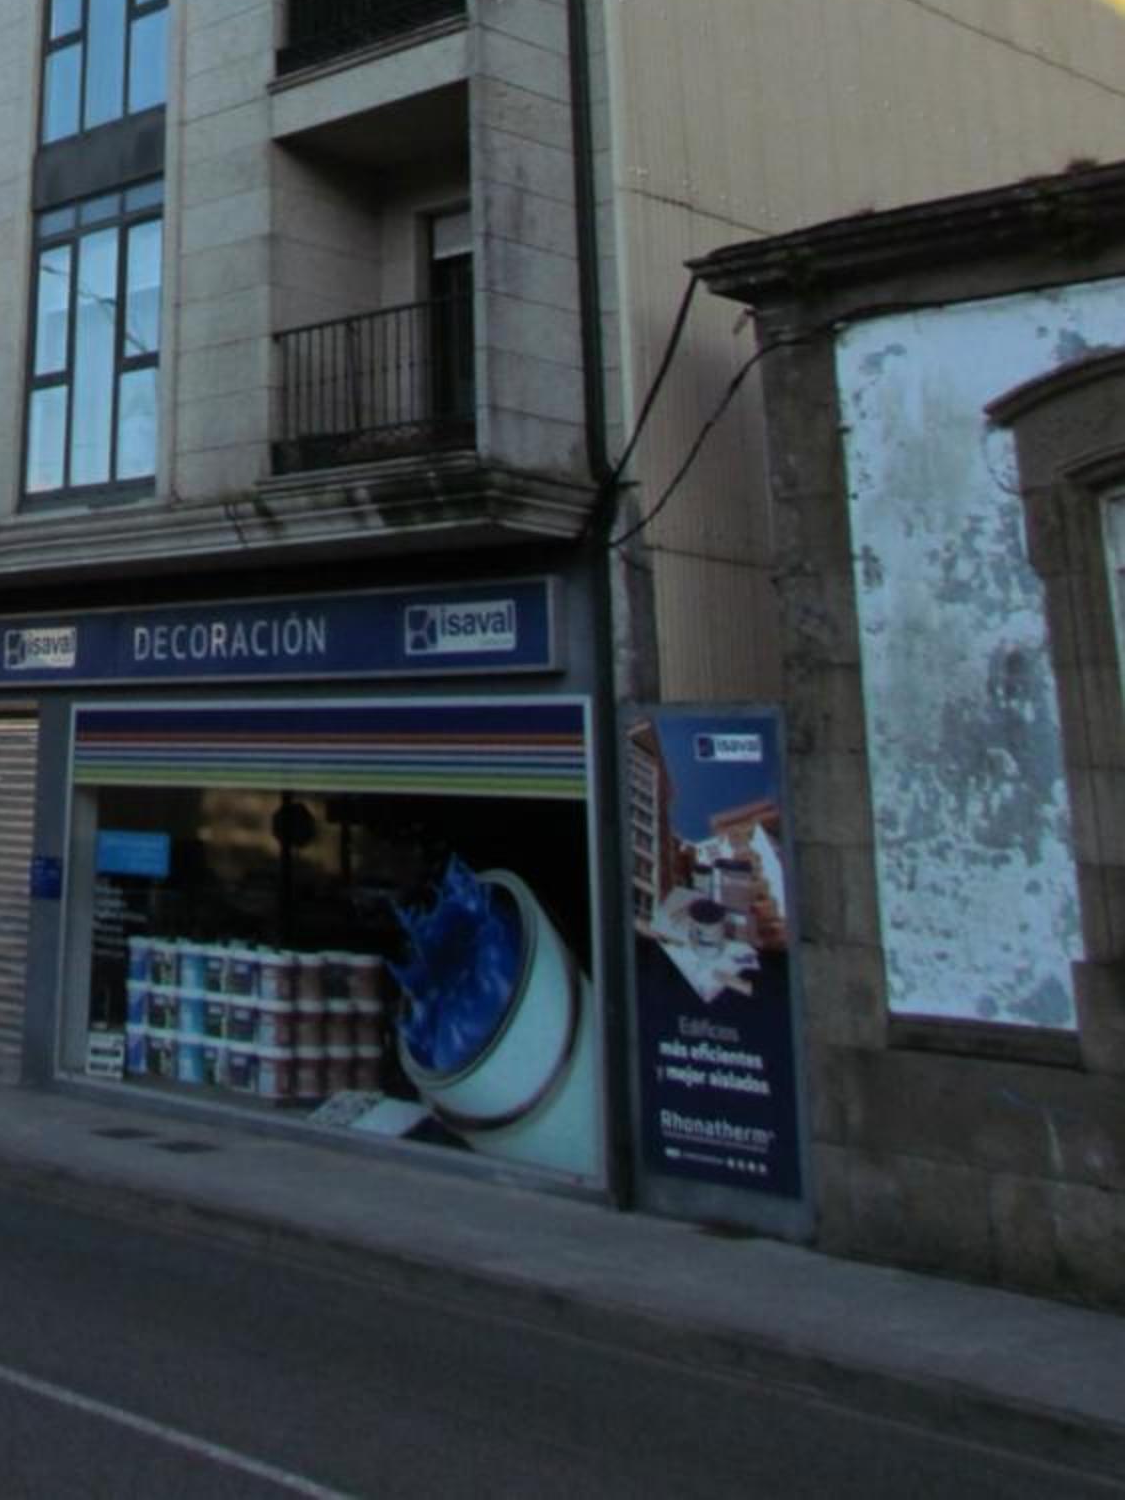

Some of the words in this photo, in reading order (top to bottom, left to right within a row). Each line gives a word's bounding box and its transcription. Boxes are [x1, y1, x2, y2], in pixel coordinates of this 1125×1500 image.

[132, 610, 328, 662] DECORACIÓN
[439, 604, 513, 639] isaval
[23, 629, 75, 658] isaval
[690, 1040, 764, 1071] eficientes
[665, 1064, 706, 1089] mejor
[708, 1068, 771, 1096] aislados
